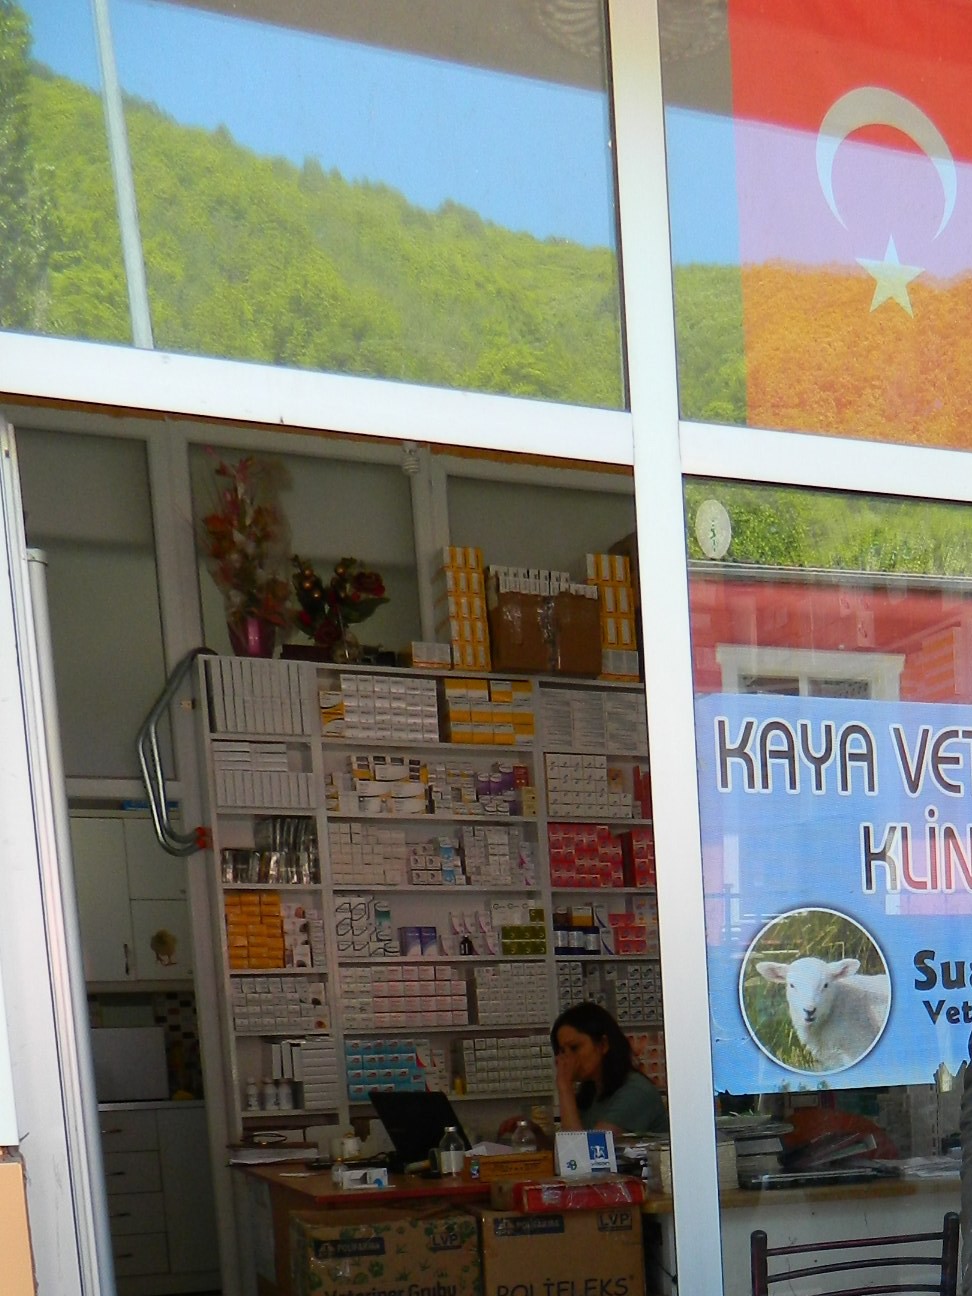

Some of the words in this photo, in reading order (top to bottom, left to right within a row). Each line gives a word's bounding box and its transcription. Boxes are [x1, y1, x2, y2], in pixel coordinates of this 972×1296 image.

[715, 717, 877, 794] KAYA
[922, 999, 972, 1025] Vet
[600, 1213, 631, 1226] LVP
[433, 1233, 458, 1246] LVP
